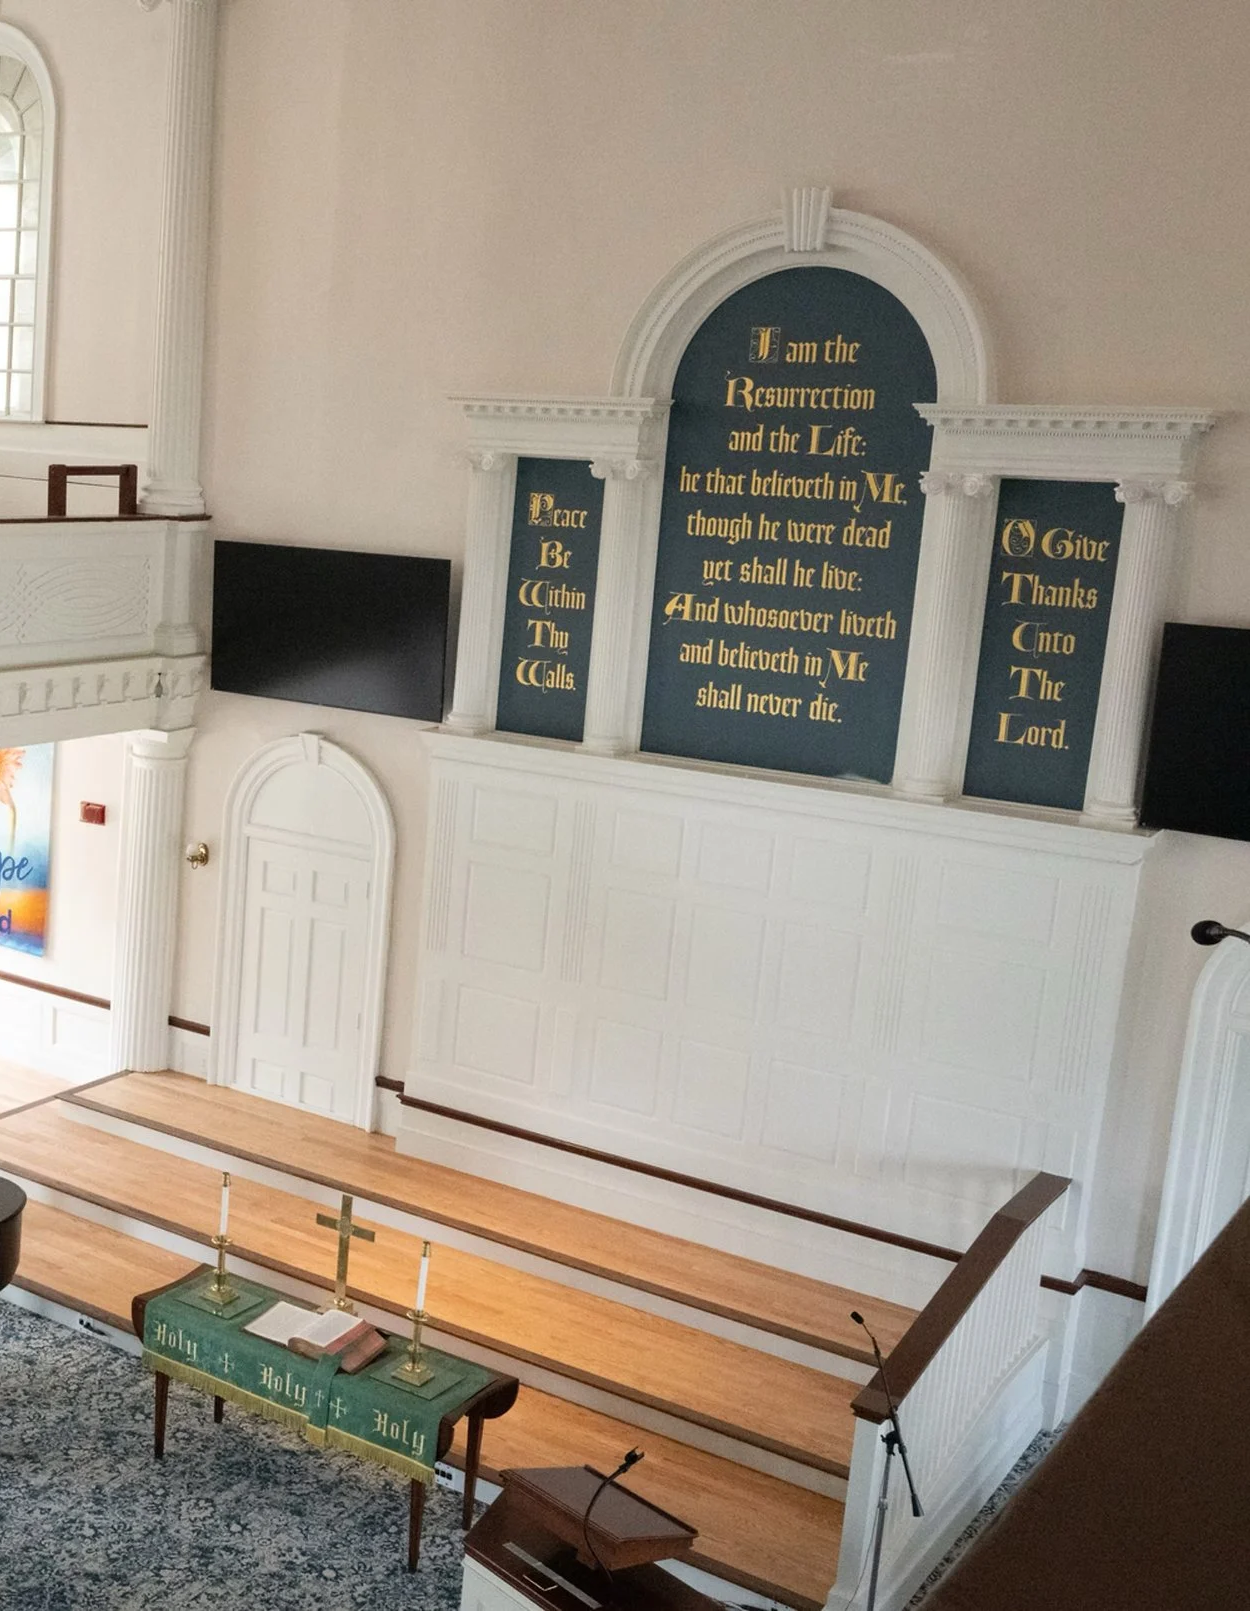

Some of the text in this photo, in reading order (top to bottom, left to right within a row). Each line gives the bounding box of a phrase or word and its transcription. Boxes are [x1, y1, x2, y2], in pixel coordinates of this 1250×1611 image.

[785, 340, 817, 363] am
[823, 334, 861, 363] the
[724, 373, 876, 412] Resurrection
[728, 423, 867, 457] and the Life:
[679, 466, 908, 512] he that believeth in Me.
[528, 492, 588, 529] Peace
[686, 509, 892, 549] though he were dead
[535, 536, 572, 570] Be
[1002, 518, 1110, 562] O Give
[702, 556, 862, 592] yet shall he live:
[1001, 571, 1098, 610] Thanks
[518, 578, 586, 615] Within
[663, 592, 898, 639] And whosoever liveth
[527, 619, 569, 655] Thy
[1011, 620, 1076, 658] Unto
[515, 656, 576, 694] Walls.
[679, 638, 870, 688] and believeth in Me
[696, 681, 842, 723] shall never die.
[1009, 665, 1067, 702] The
[993, 712, 1069, 750] Lord.
[153, 1320, 426, 1457] Holy Holy Holy
